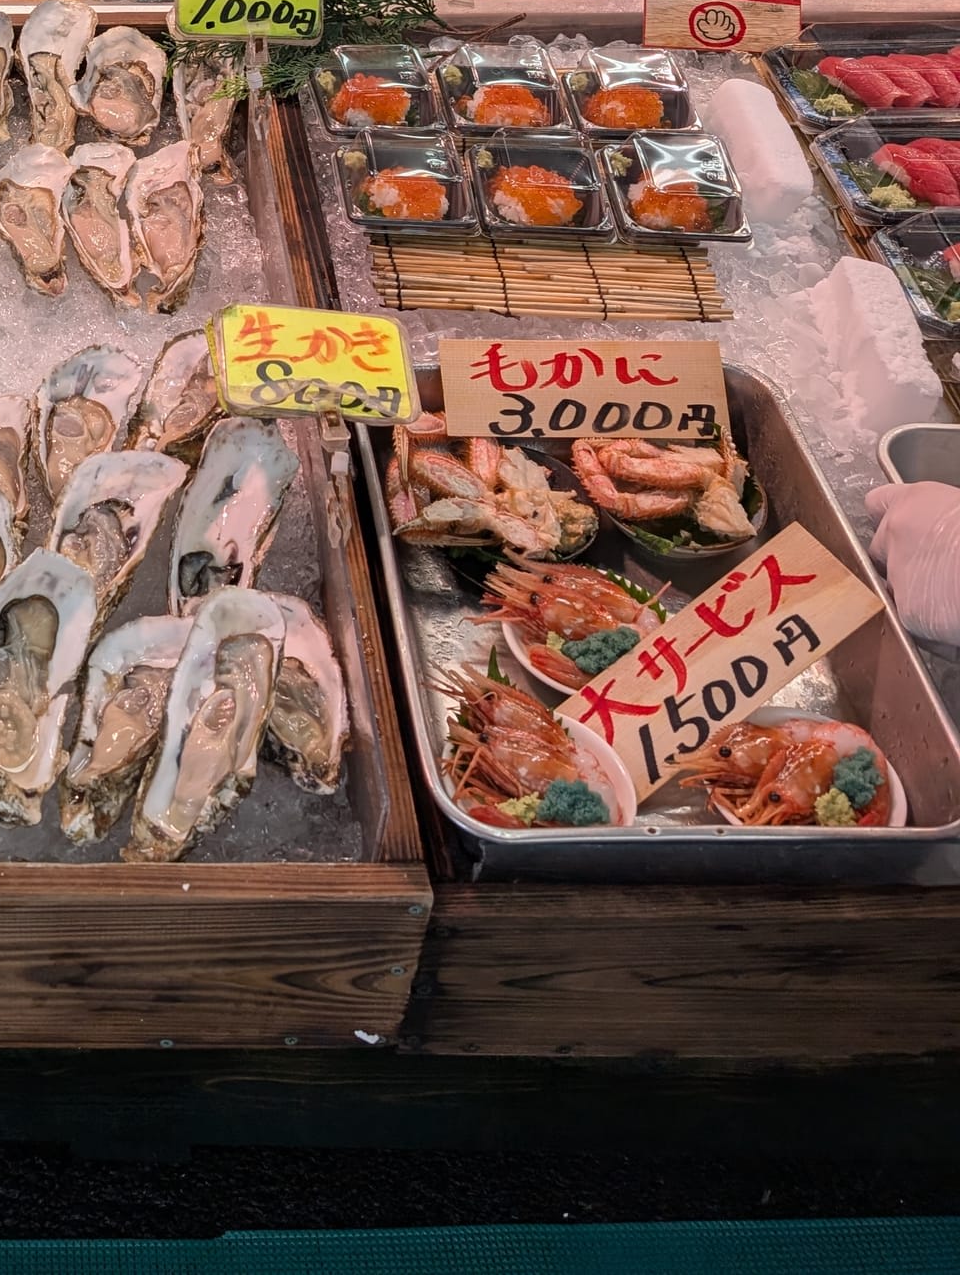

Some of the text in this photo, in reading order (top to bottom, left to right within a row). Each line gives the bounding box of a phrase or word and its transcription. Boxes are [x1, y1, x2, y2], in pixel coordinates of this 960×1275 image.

[232, 310, 391, 373] 生かき
[469, 343, 679, 392] 毛かに
